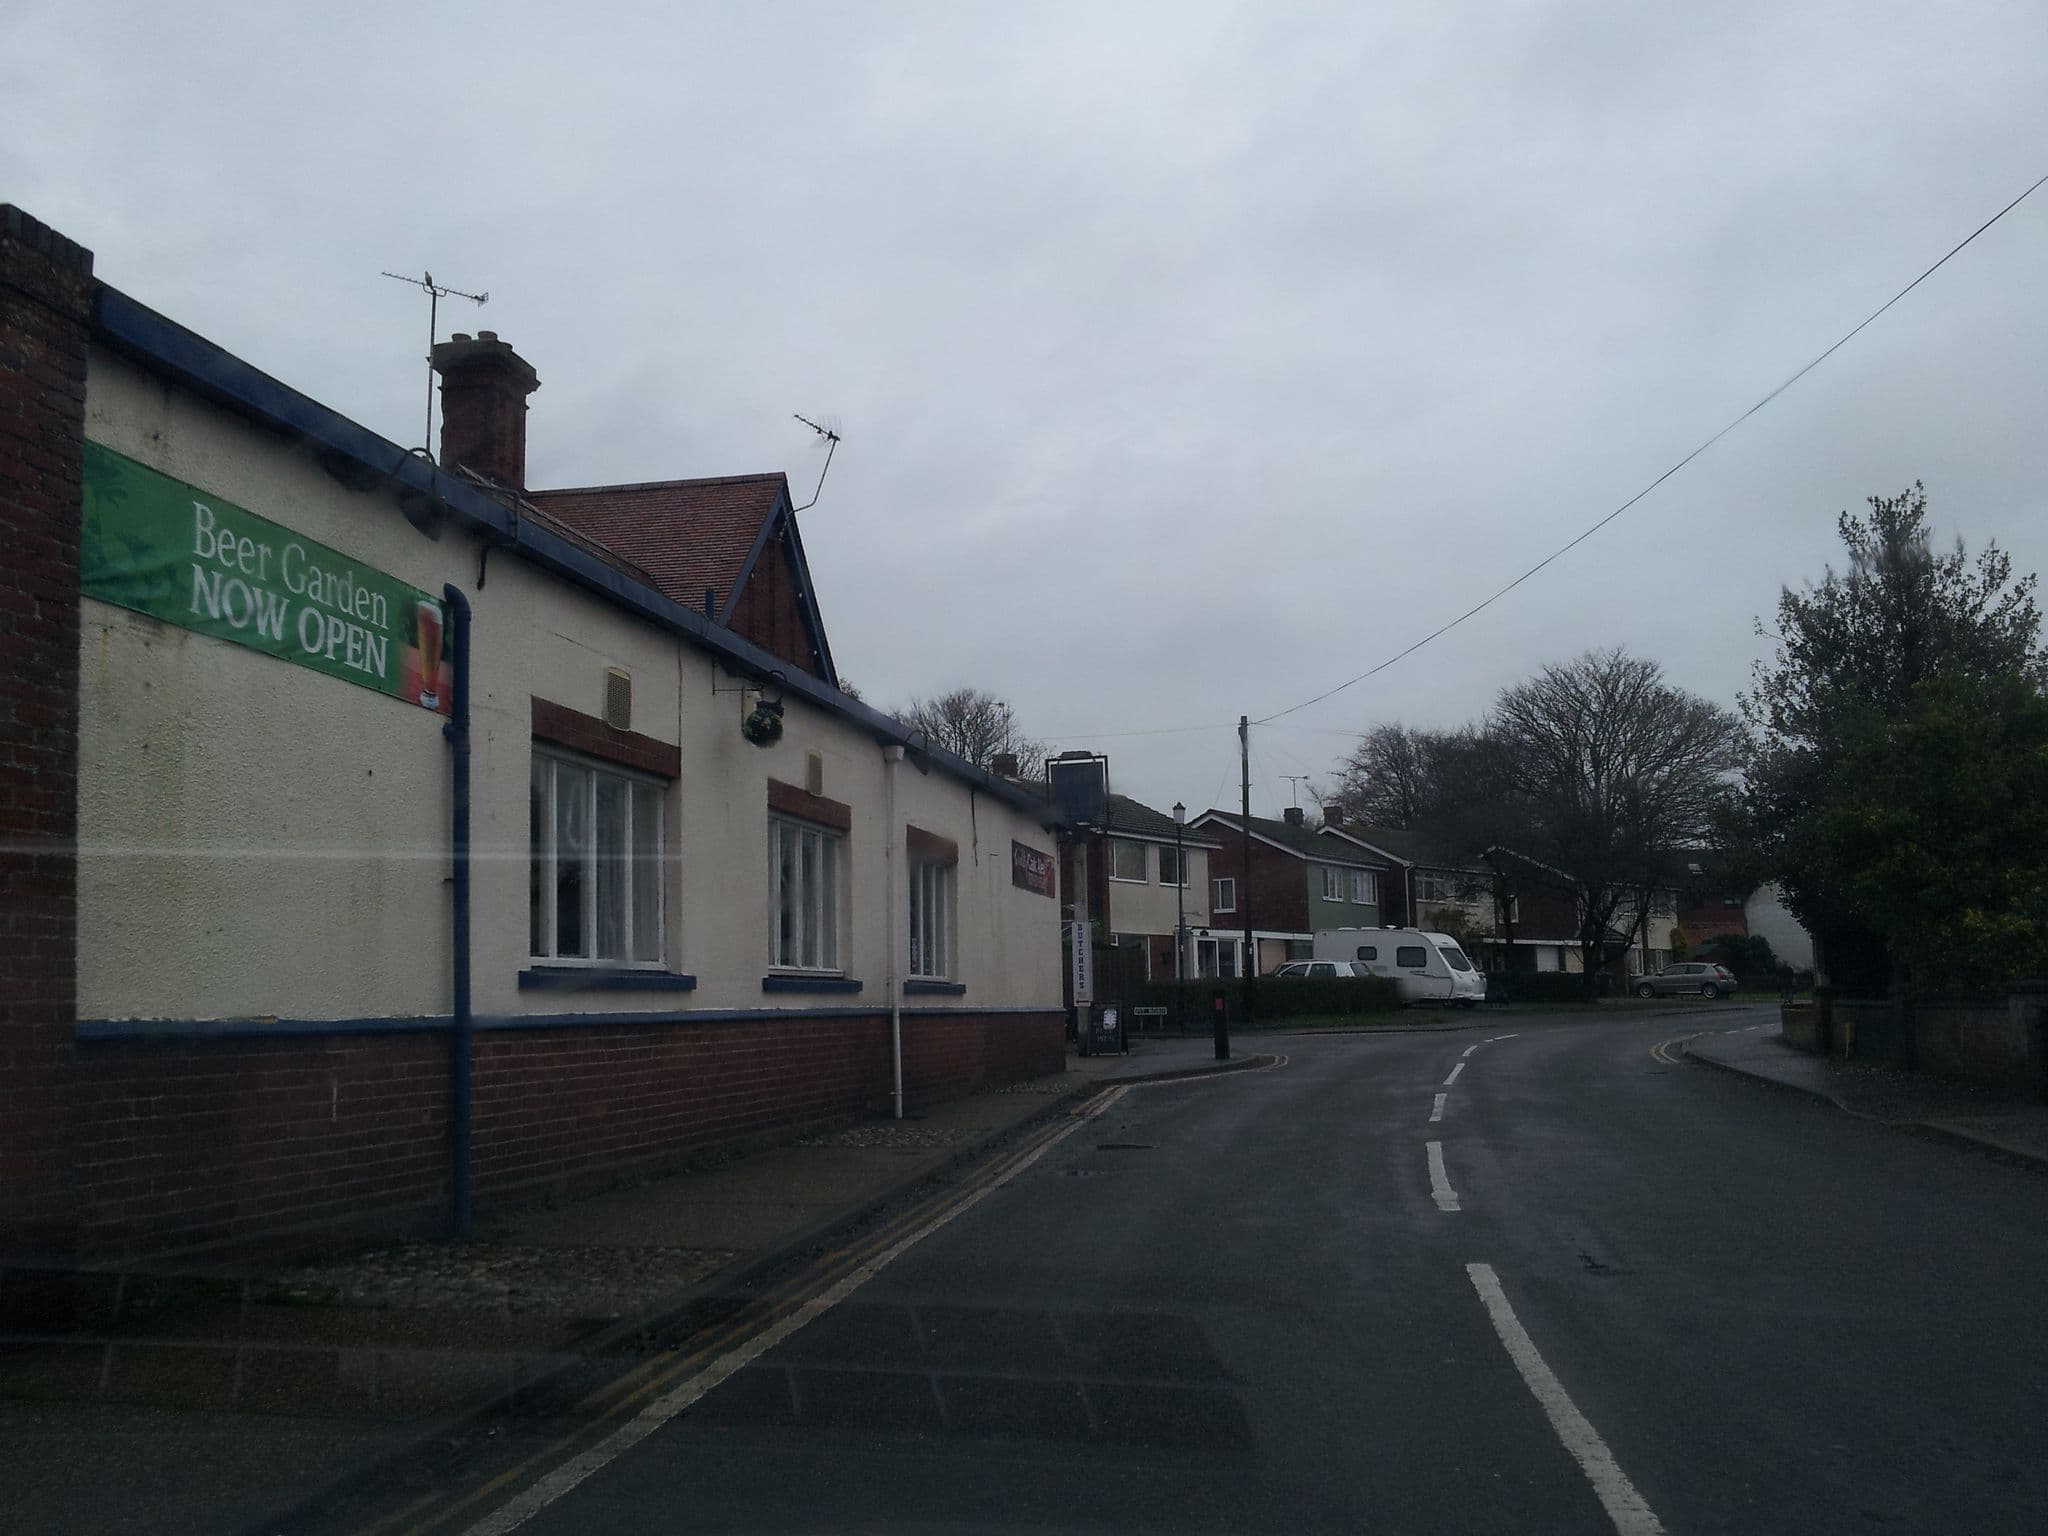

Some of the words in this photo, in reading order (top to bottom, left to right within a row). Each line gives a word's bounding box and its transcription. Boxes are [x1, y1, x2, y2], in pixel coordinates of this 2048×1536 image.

[191, 563, 290, 641] NOW
[298, 606, 389, 679] OPEN
[193, 501, 272, 582] Beer
[281, 543, 389, 630] Garden
[1077, 924, 1085, 989] BUTCHERS
